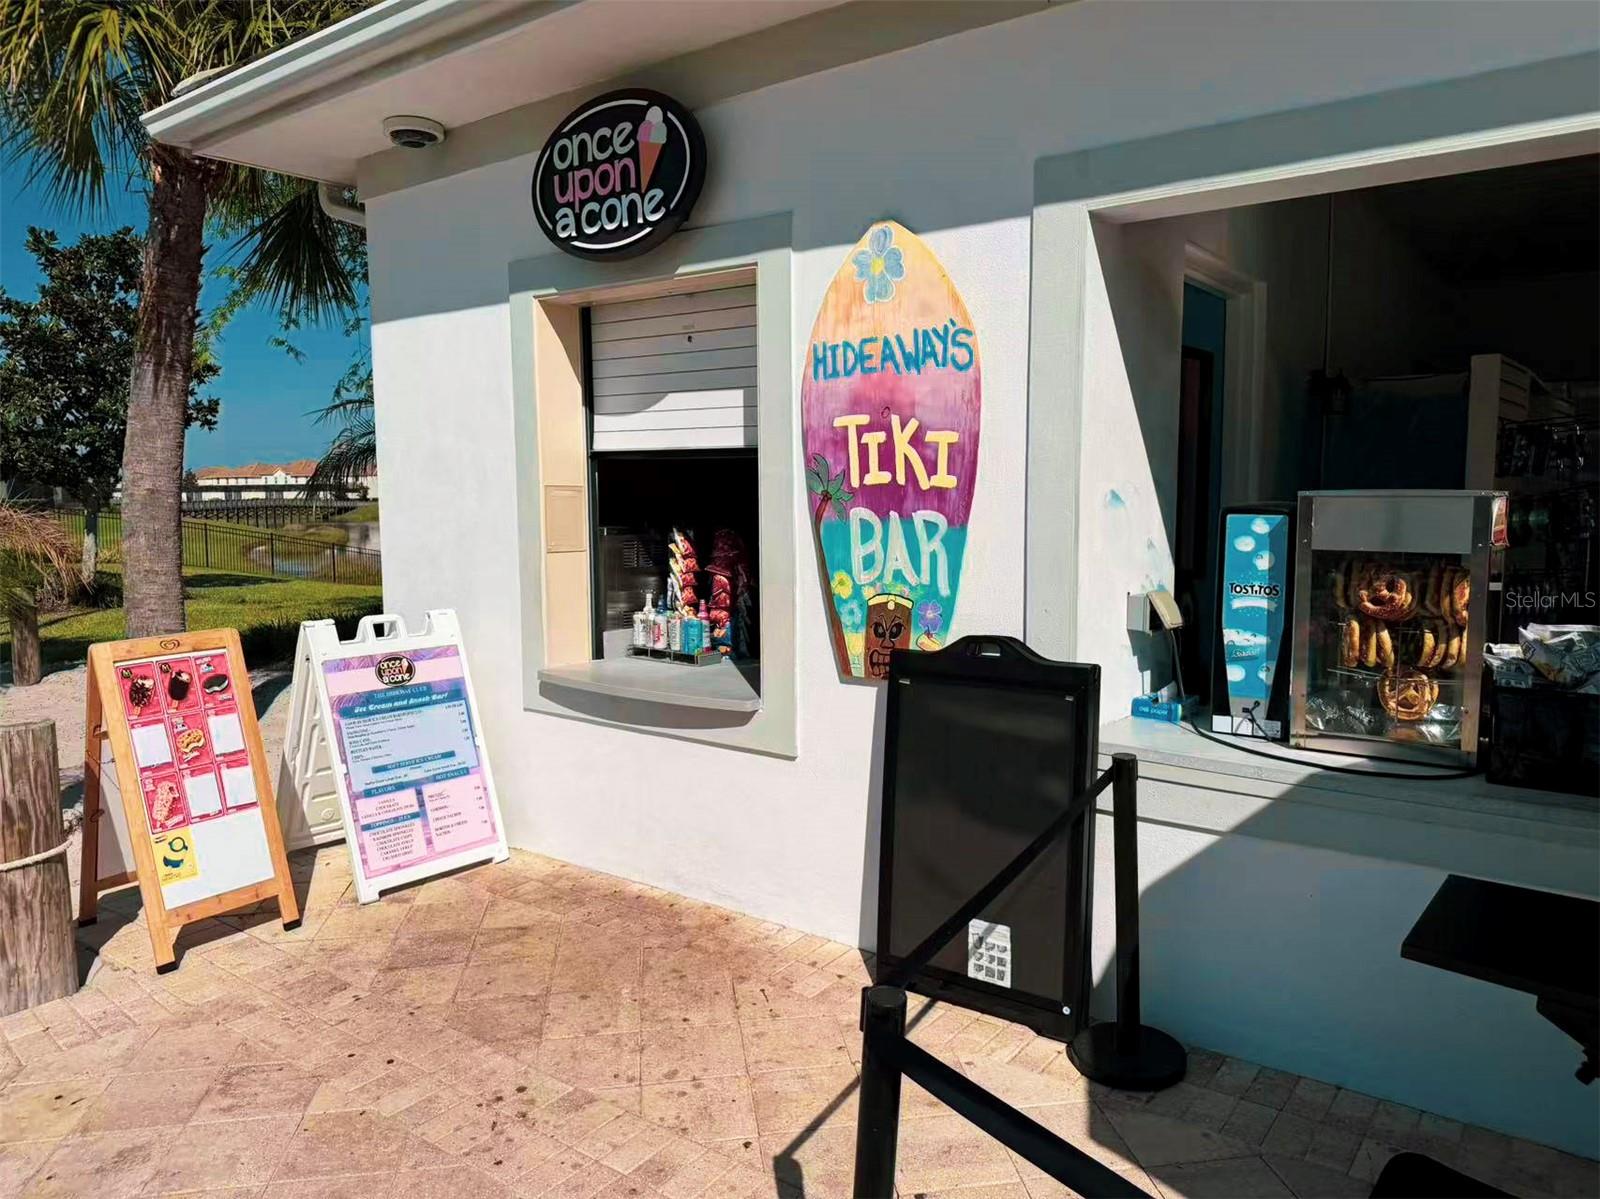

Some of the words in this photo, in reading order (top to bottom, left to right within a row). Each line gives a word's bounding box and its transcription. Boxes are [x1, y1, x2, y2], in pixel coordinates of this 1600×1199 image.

[553, 122, 635, 169] once
[554, 158, 636, 213] upon
[555, 207, 577, 238] a
[581, 189, 665, 234] cone
[812, 319, 973, 381] HIDEAWAY'S
[833, 414, 959, 491] TIKI
[849, 507, 950, 597] BAR
[380, 660, 401, 669] once
[368, 702, 392, 711] Cream
